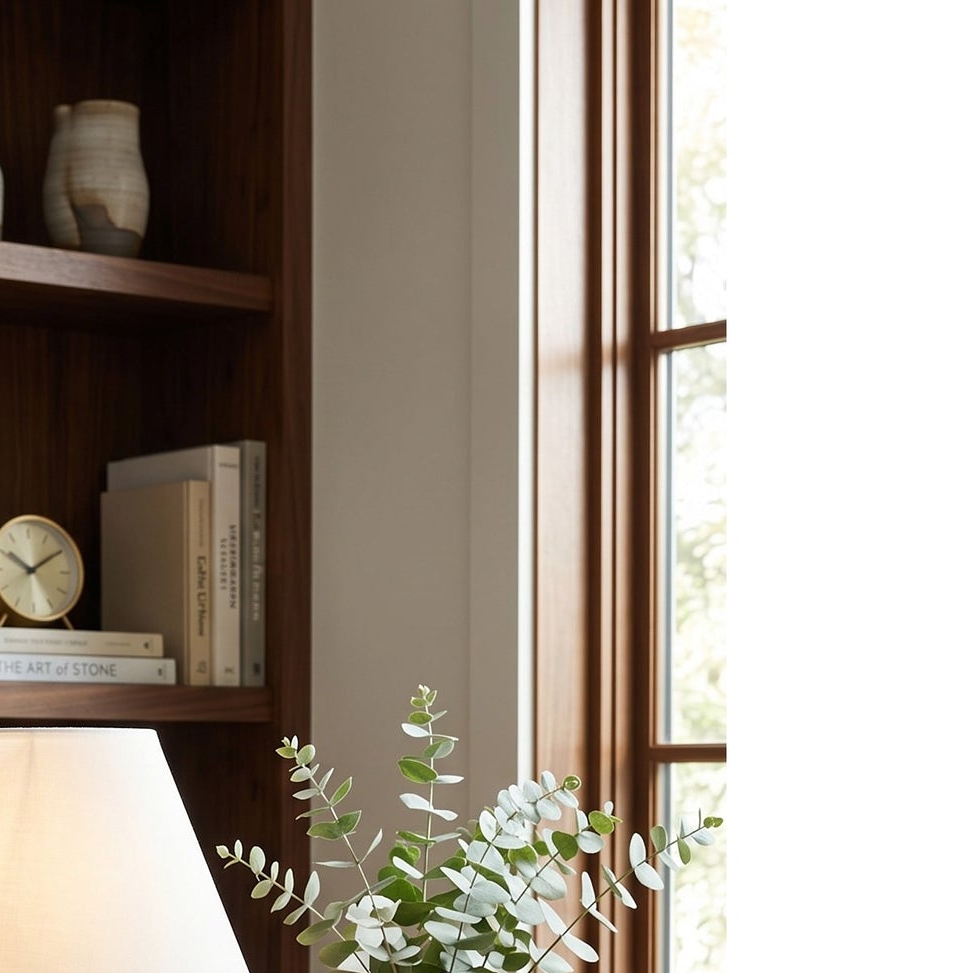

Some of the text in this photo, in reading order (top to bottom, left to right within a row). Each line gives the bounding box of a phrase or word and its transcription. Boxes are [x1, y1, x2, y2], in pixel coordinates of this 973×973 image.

[26, 661, 52, 676] ART
[56, 662, 70, 676] of
[73, 662, 117, 678] STONE
